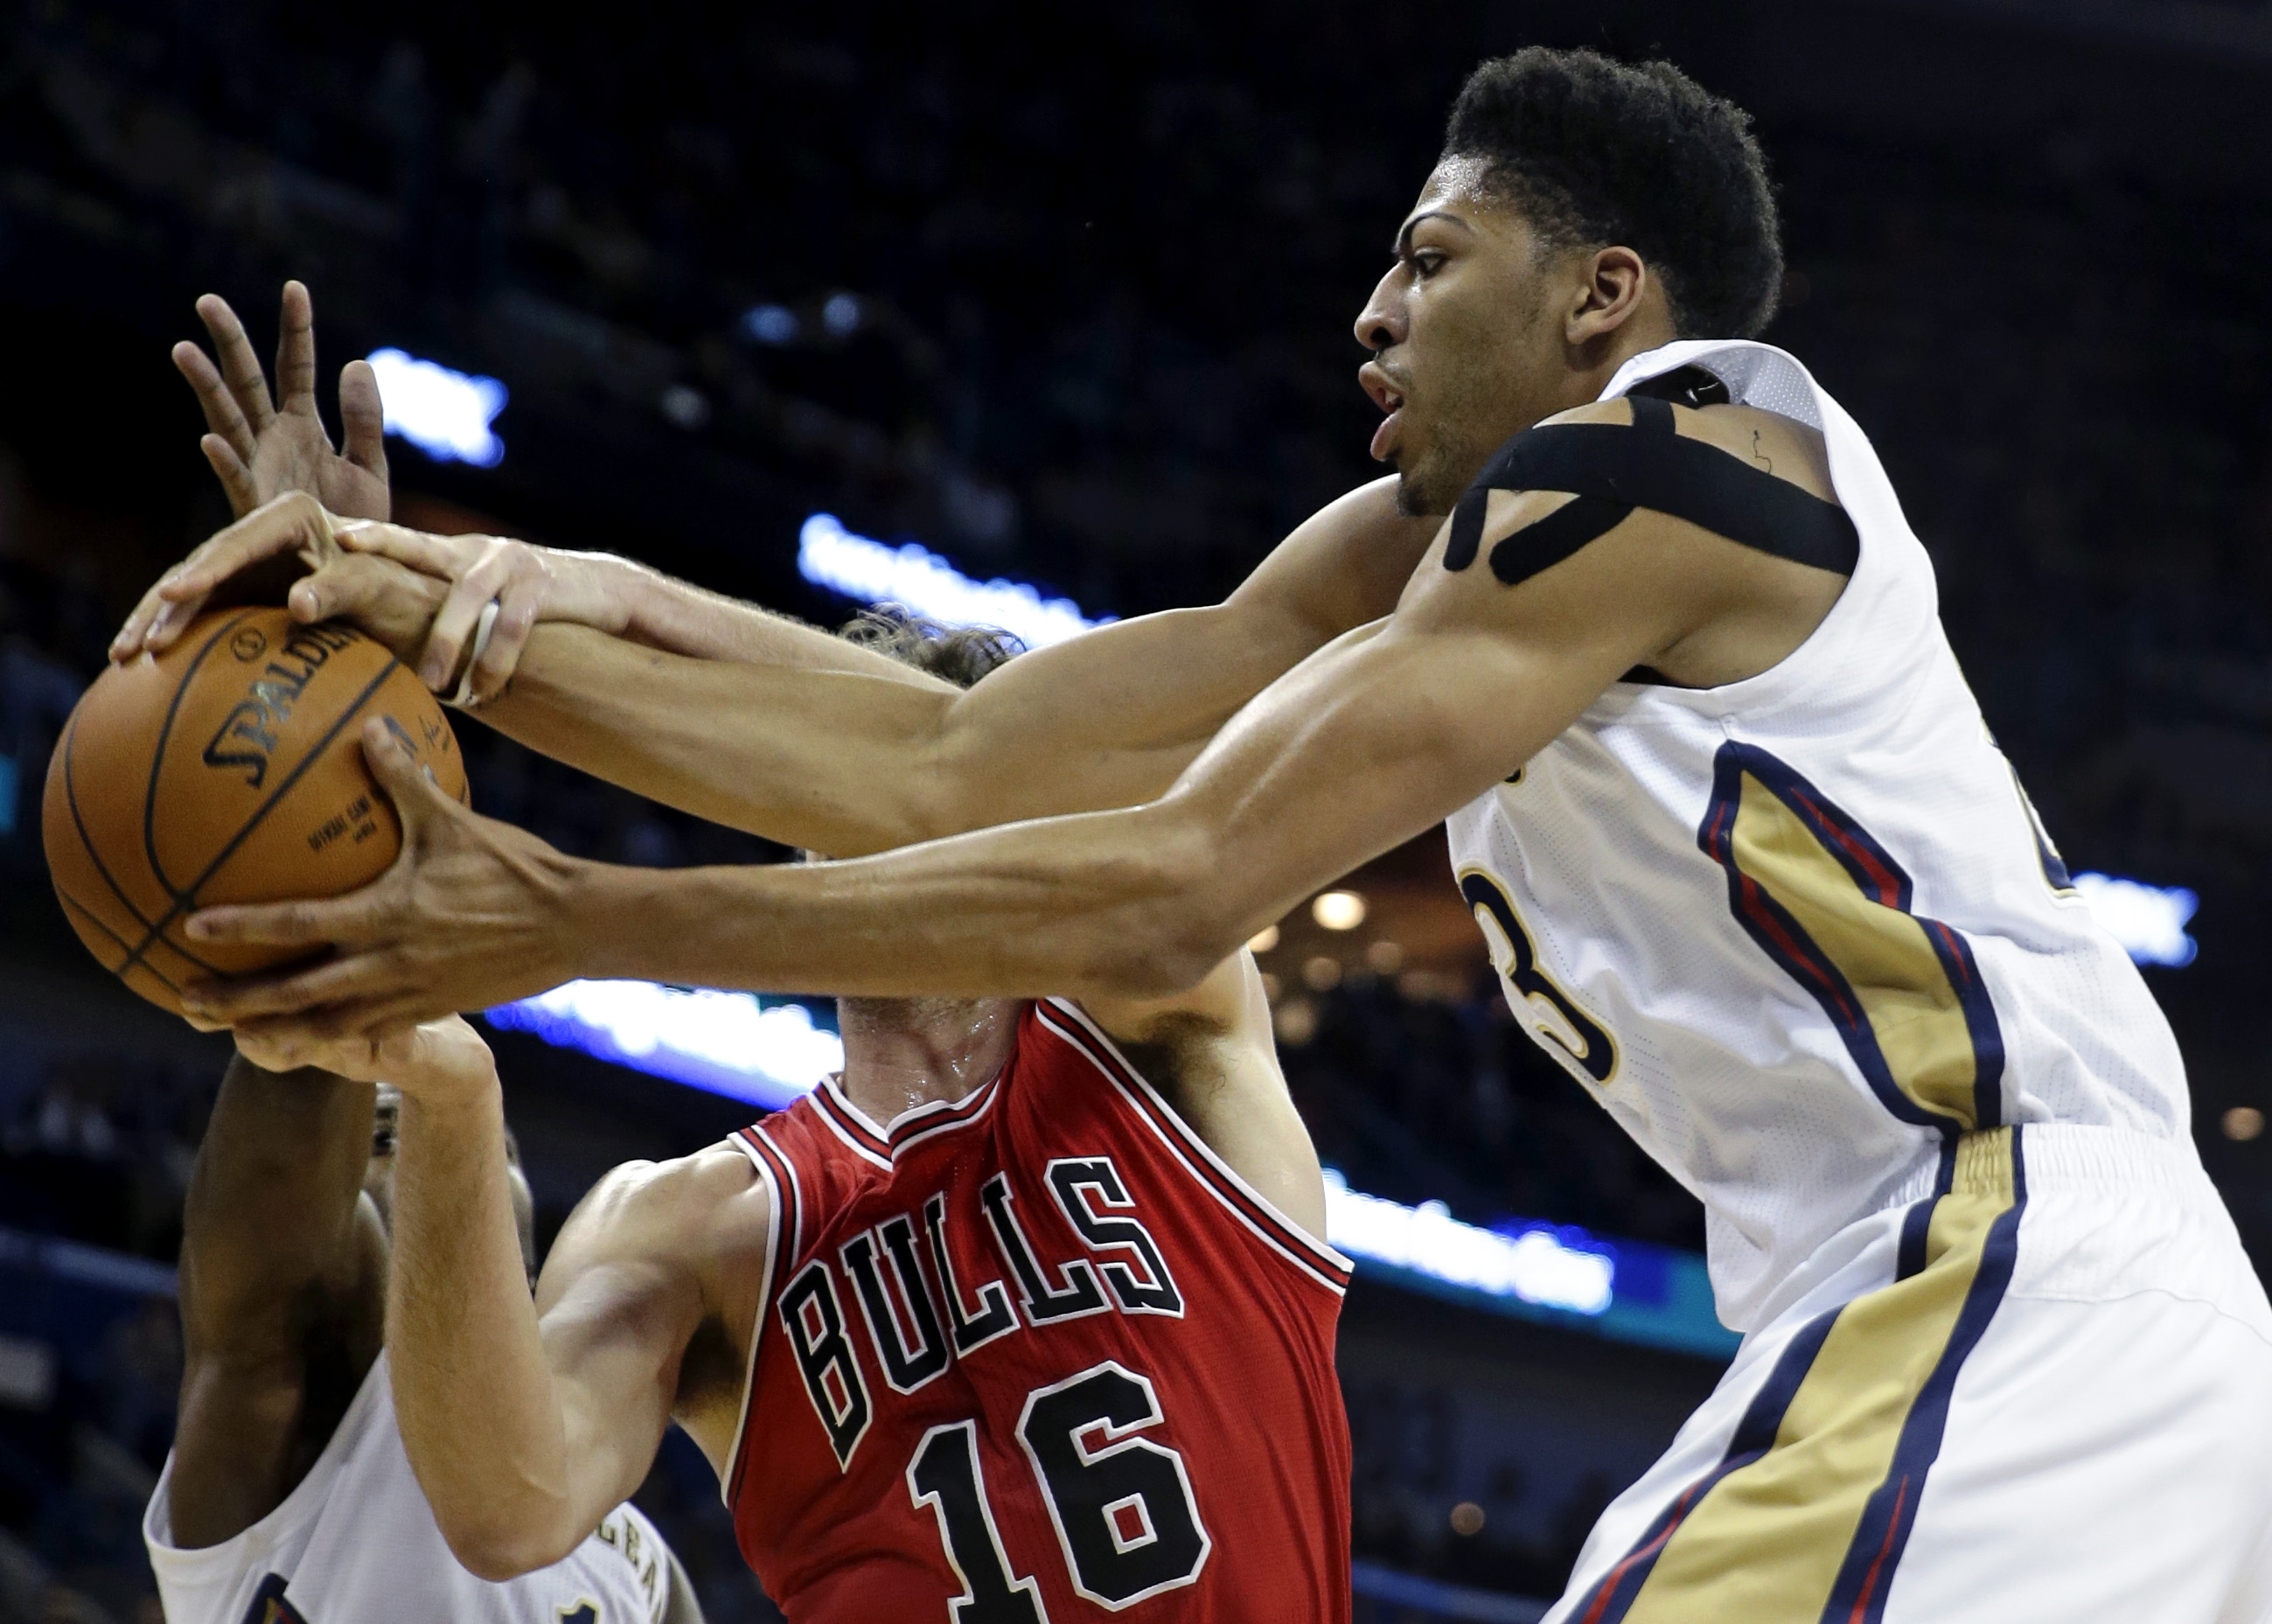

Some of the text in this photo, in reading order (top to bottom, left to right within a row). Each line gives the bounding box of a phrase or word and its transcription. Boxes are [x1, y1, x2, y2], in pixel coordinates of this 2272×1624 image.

[1458, 861, 1620, 1087] 3
[777, 1156, 1185, 1474] BULLS
[906, 1360, 1213, 1624] 16
